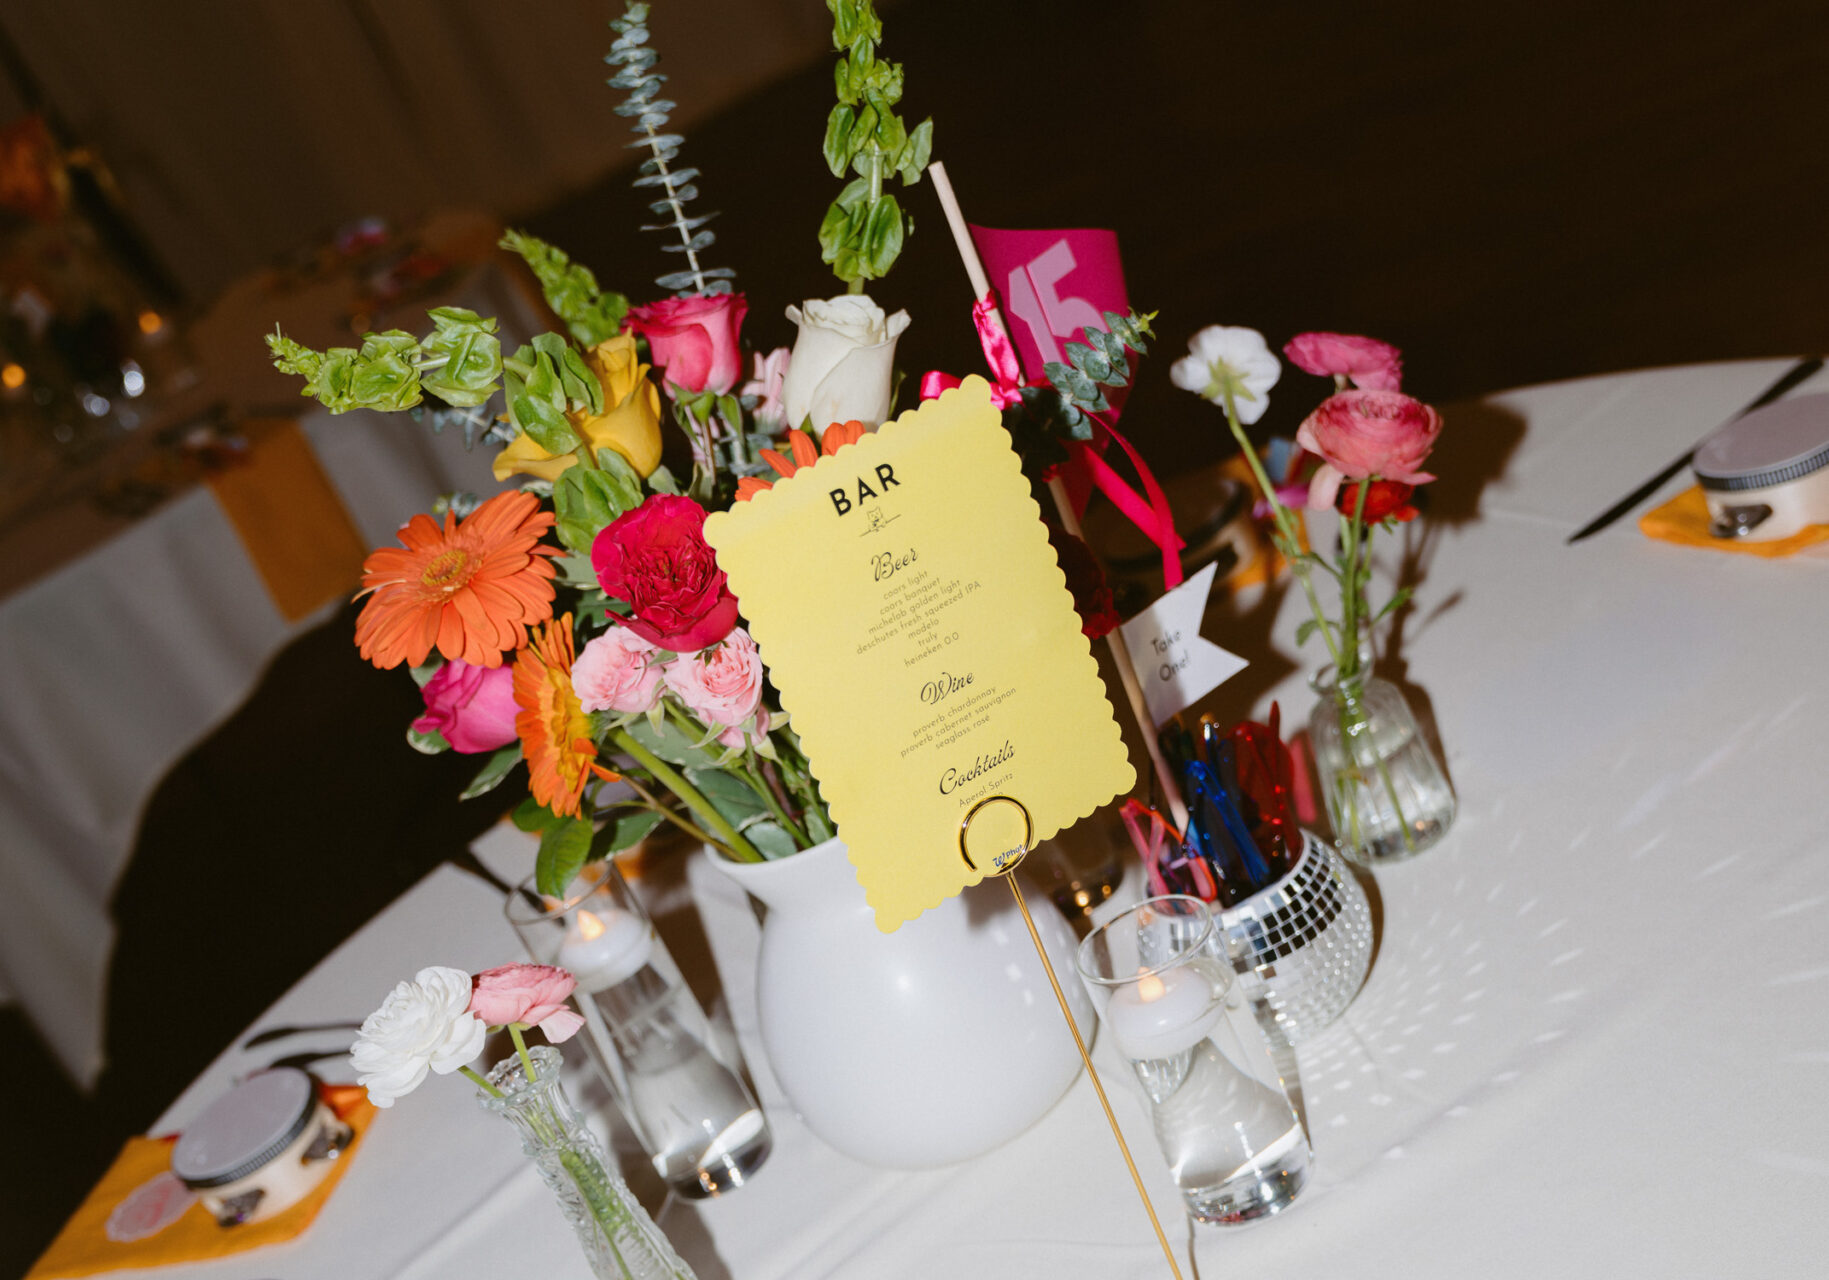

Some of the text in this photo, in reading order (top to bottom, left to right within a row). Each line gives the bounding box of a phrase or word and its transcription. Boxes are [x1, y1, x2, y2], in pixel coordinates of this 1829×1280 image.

[1008, 238, 1109, 366] 15
[828, 462, 901, 517] BAR
[870, 547, 919, 582] Beer
[880, 577, 941, 615] coors banquet
[883, 570, 929, 601] coors light
[856, 580, 982, 655] deschutes fresh squeezed IPA
[868, 579, 961, 634] michelob golden light
[908, 618, 940, 640] modelo
[918, 631, 938, 647] truly
[1151, 630, 1182, 655] Take
[904, 642, 943, 668] heineken
[1159, 650, 1191, 681] One!
[920, 671, 975, 705] Wine
[899, 686, 1017, 759] proverb cabernet sauvignon
[912, 686, 997, 739] proverb chardonnay
[935, 726, 971, 750] seaglass
[939, 740, 1016, 795] Cocktails
[959, 786, 986, 808] Aperol
[988, 773, 1014, 791] Spritz
